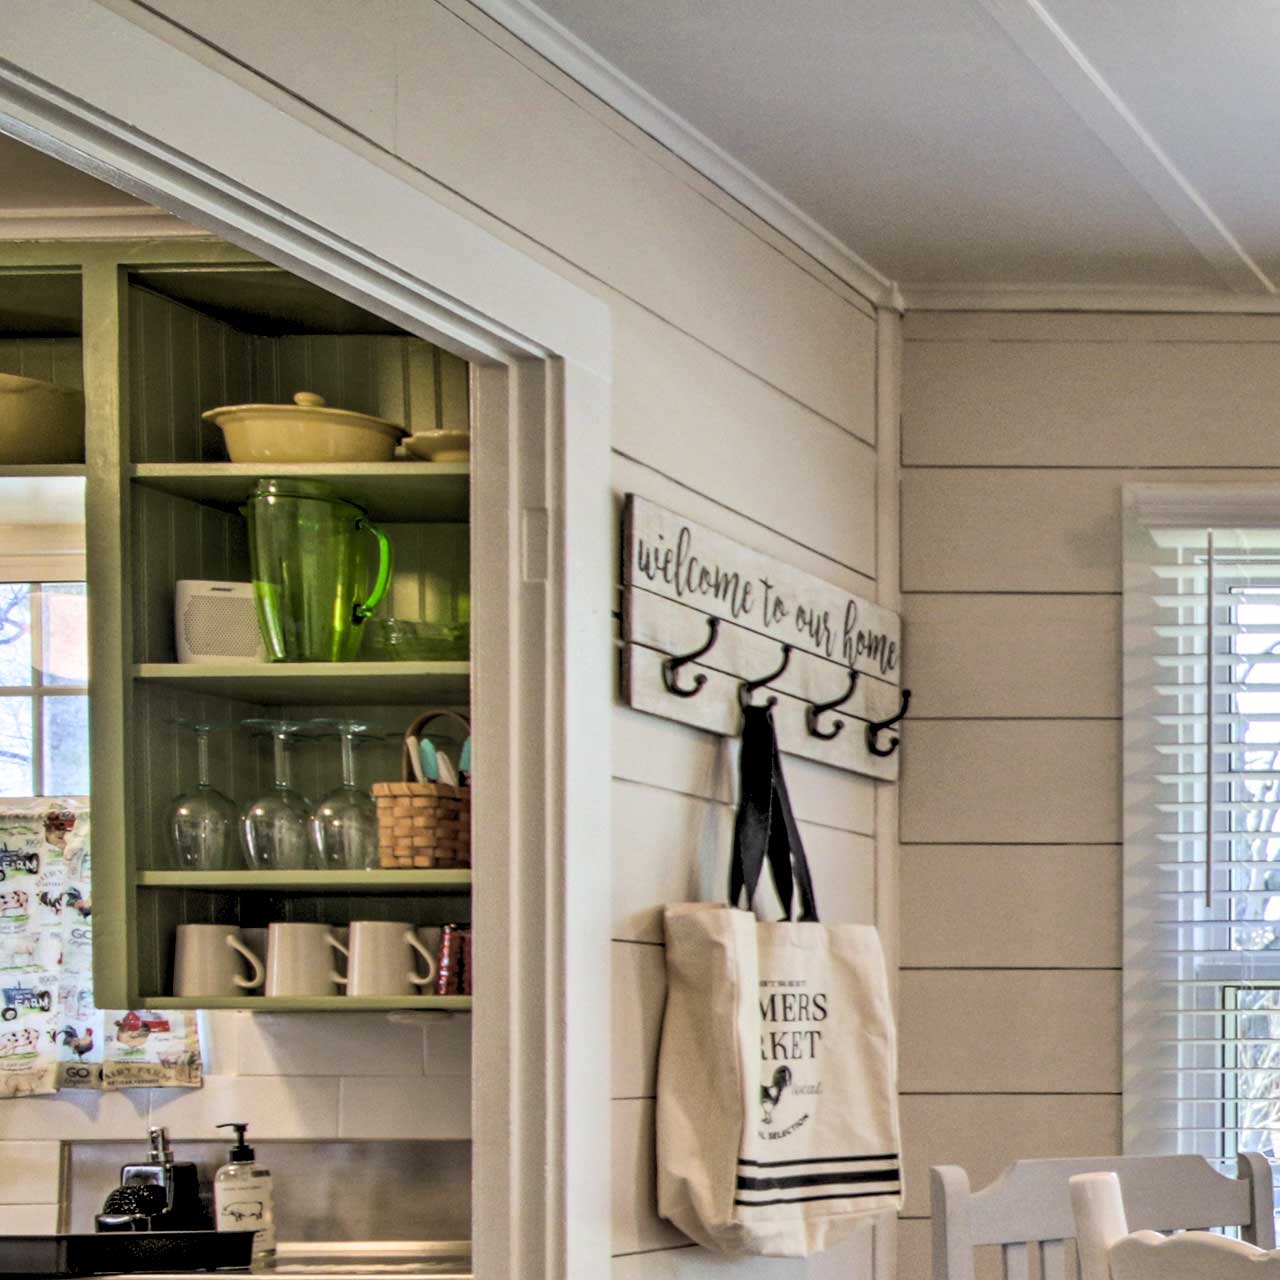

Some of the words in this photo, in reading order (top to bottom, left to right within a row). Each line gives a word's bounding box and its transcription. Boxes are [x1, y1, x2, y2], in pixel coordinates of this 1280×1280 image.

[638, 527, 752, 619] welcome
[759, 578, 789, 627] to
[796, 603, 836, 657] our
[843, 600, 898, 675] home
[15, 996, 49, 1009] FARM
[759, 993, 828, 1022] MERS
[66, 1067, 90, 1079] GO
